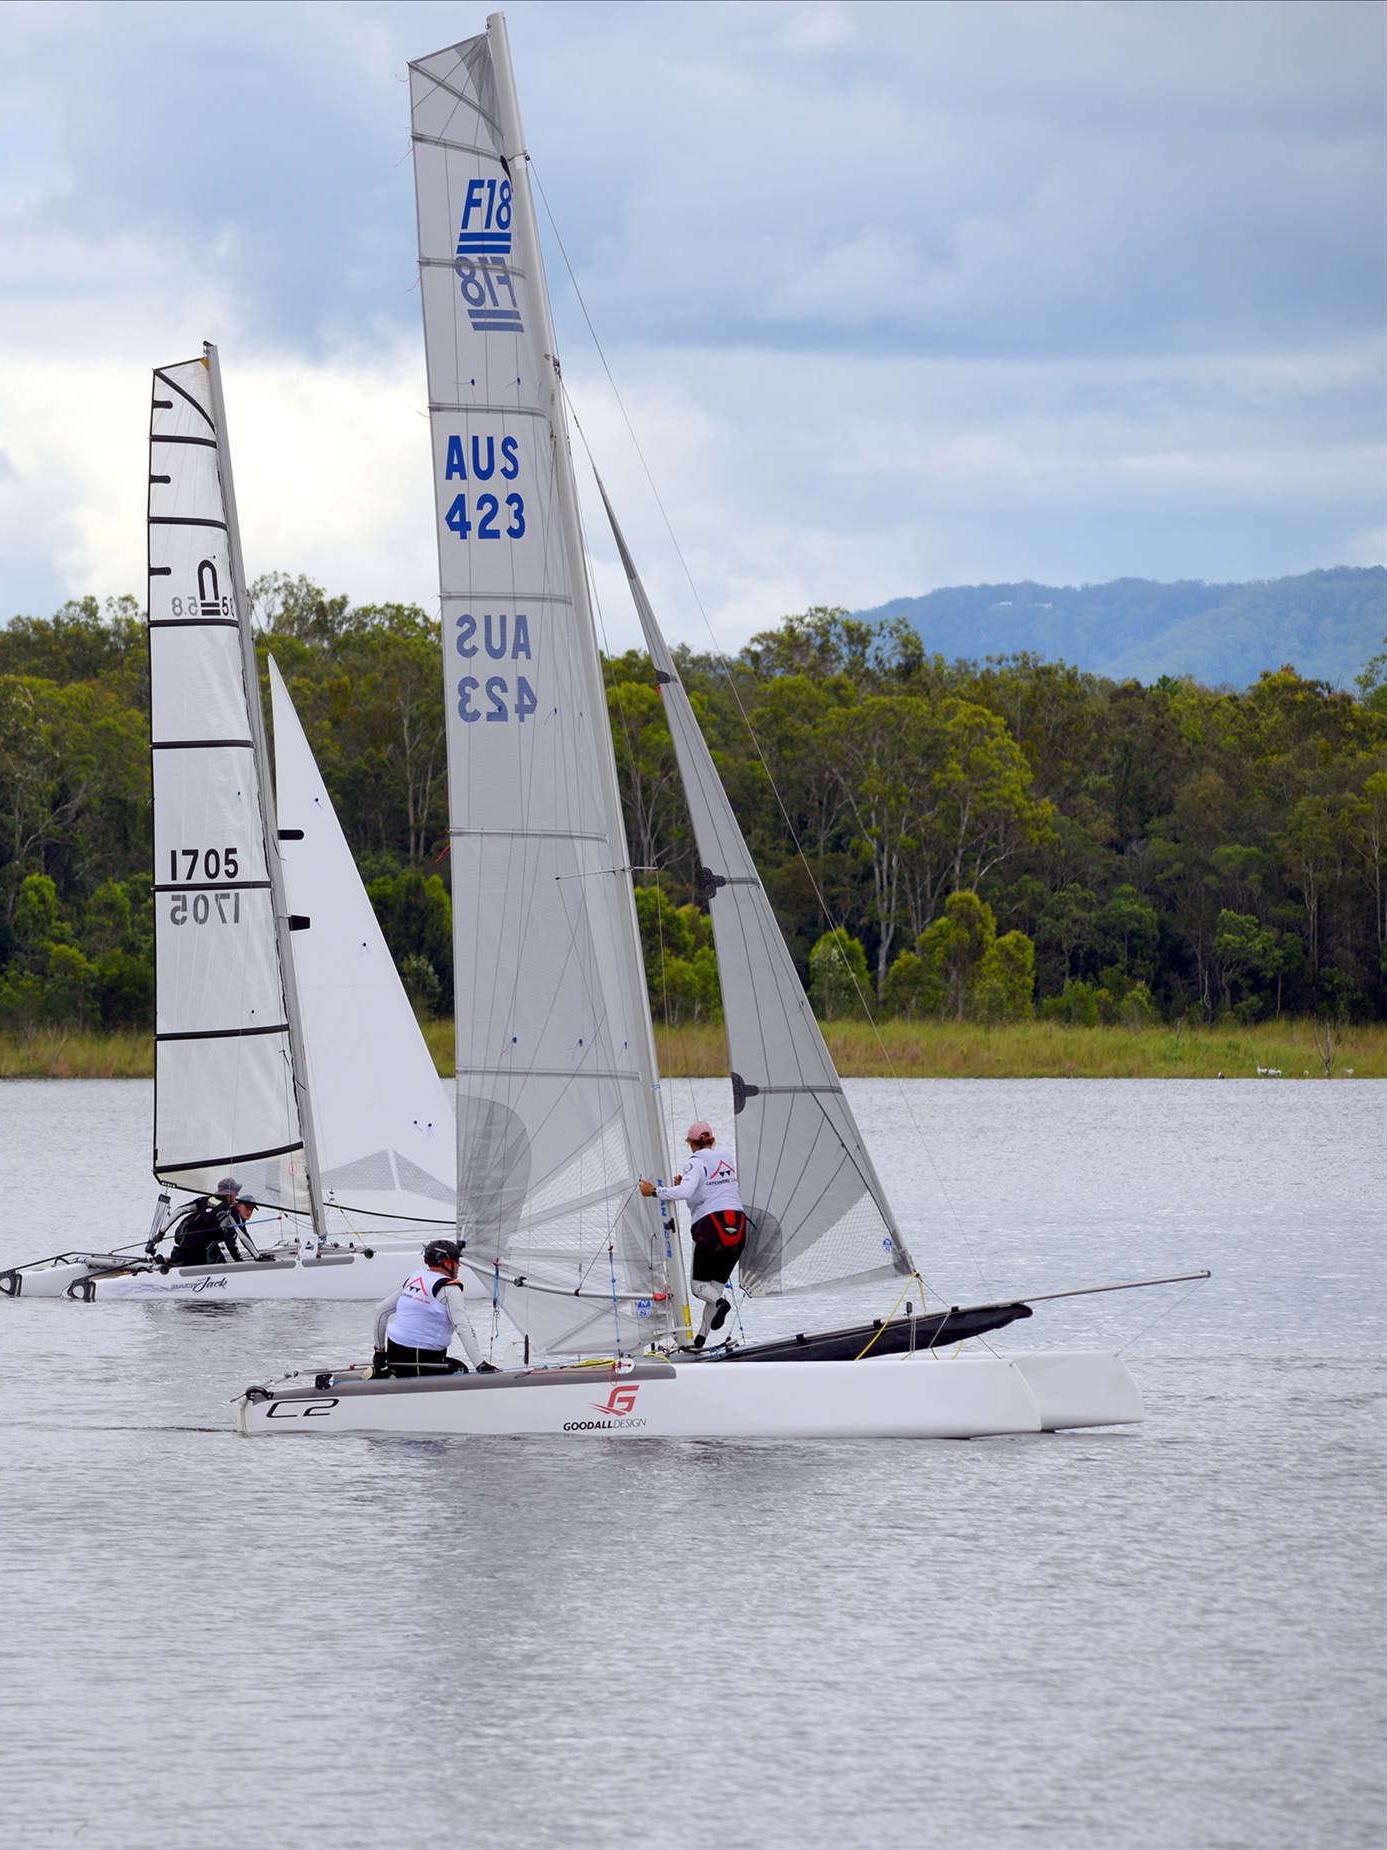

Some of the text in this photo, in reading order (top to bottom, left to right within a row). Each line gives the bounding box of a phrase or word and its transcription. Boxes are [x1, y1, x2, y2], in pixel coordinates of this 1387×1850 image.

[461, 179, 512, 230] F18
[445, 435, 519, 480] AUS
[445, 493, 526, 539] 423
[170, 848, 239, 881] 1705
[266, 1398, 340, 1418] C2
